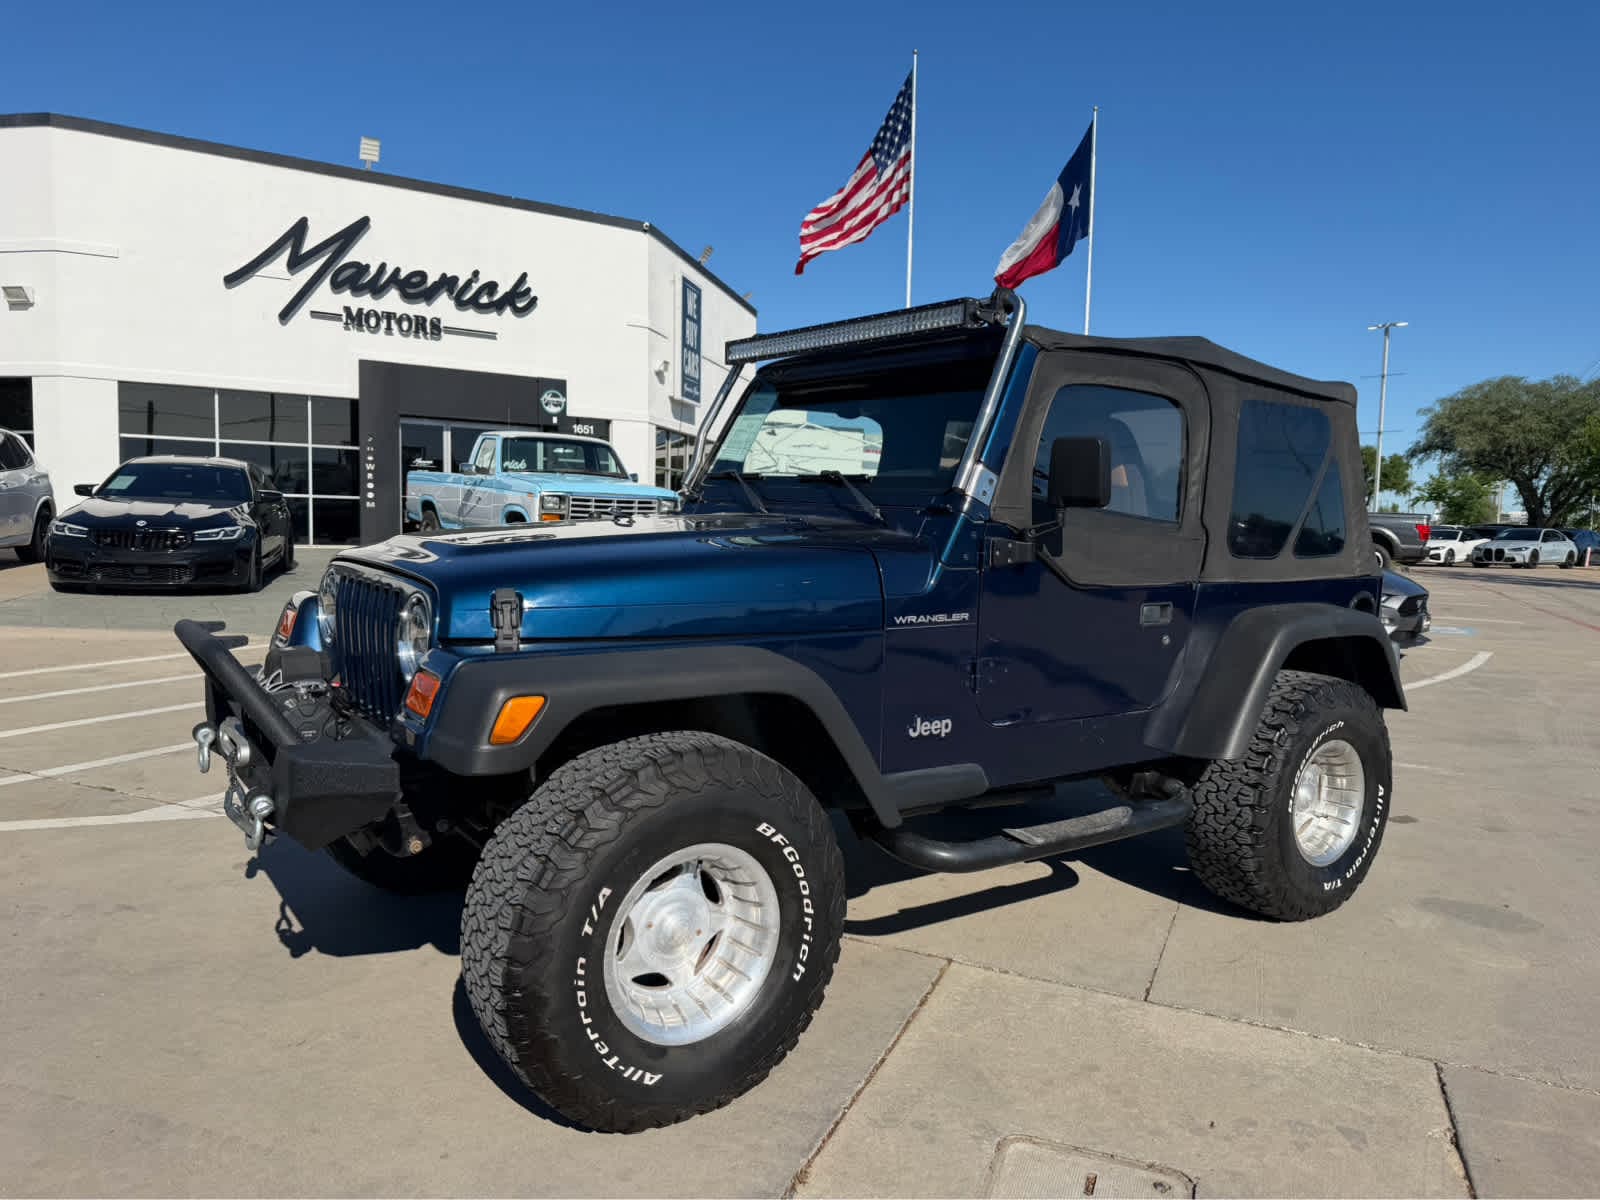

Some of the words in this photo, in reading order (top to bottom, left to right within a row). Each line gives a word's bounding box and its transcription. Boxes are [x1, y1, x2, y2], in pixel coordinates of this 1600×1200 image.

[223, 215, 538, 324] Maverick
[343, 306, 442, 339] MOTORS
[572, 424, 594, 435] 1651
[894, 612, 970, 625] WRANGLER
[908, 717, 952, 738] Jeep
[581, 887, 613, 937] T/A
[756, 822, 814, 982] BFGoodrich
[574, 957, 664, 1086] All-Terrain
